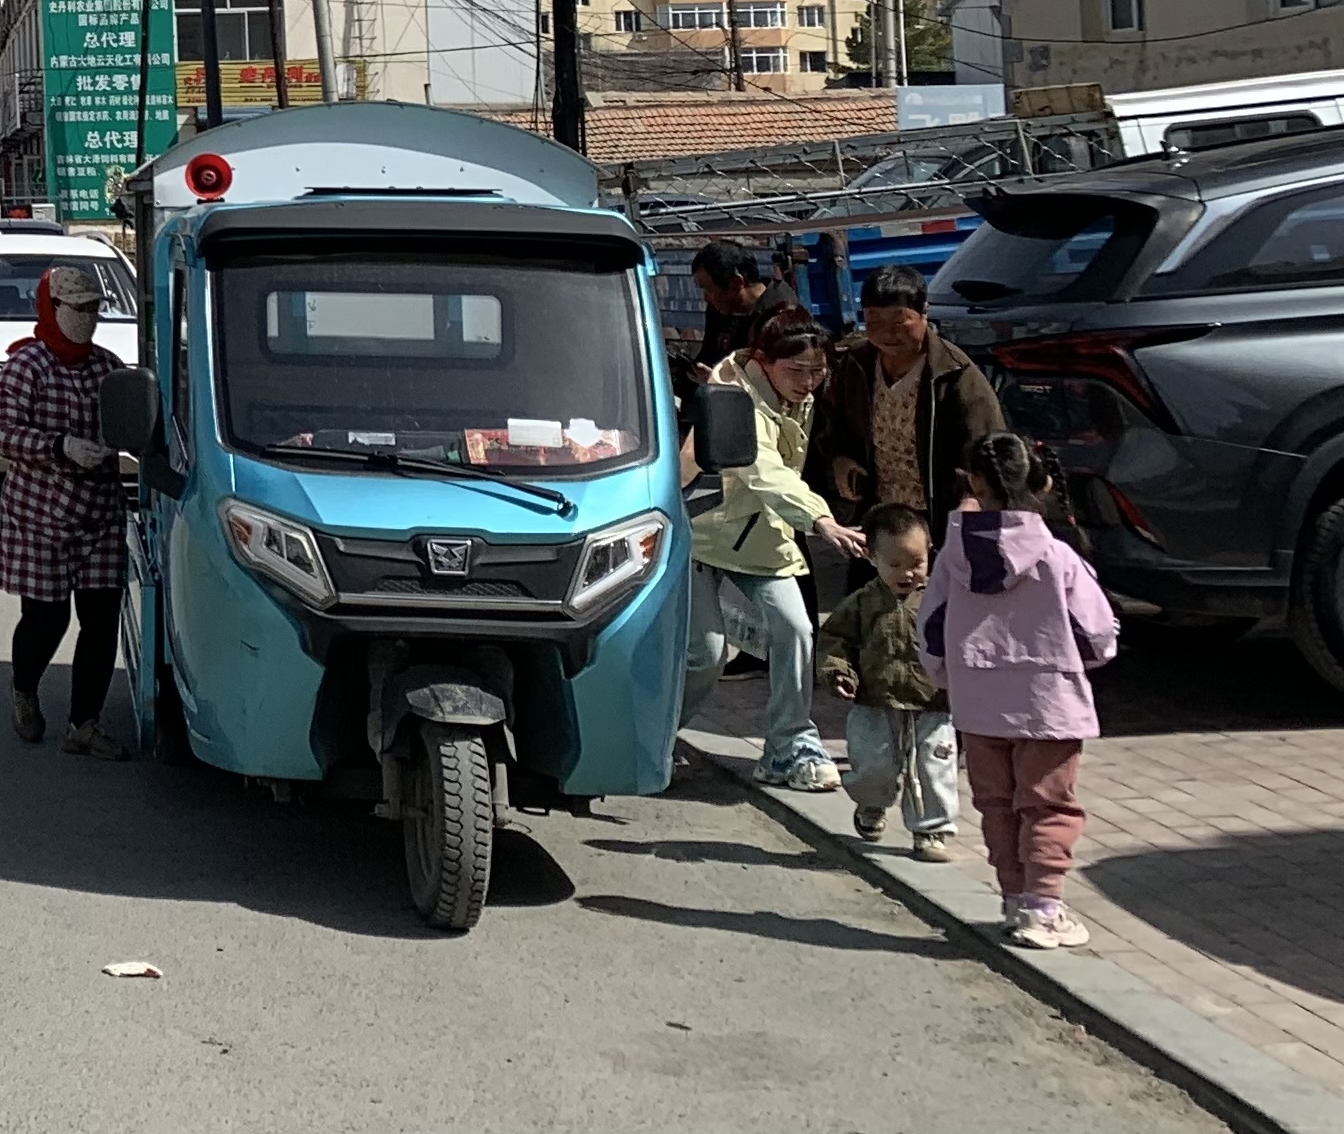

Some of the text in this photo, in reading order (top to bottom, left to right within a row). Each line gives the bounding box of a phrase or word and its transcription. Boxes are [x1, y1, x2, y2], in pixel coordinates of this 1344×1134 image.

[83, 31, 137, 48] 总代理
[85, 131, 138, 148] 总代理
